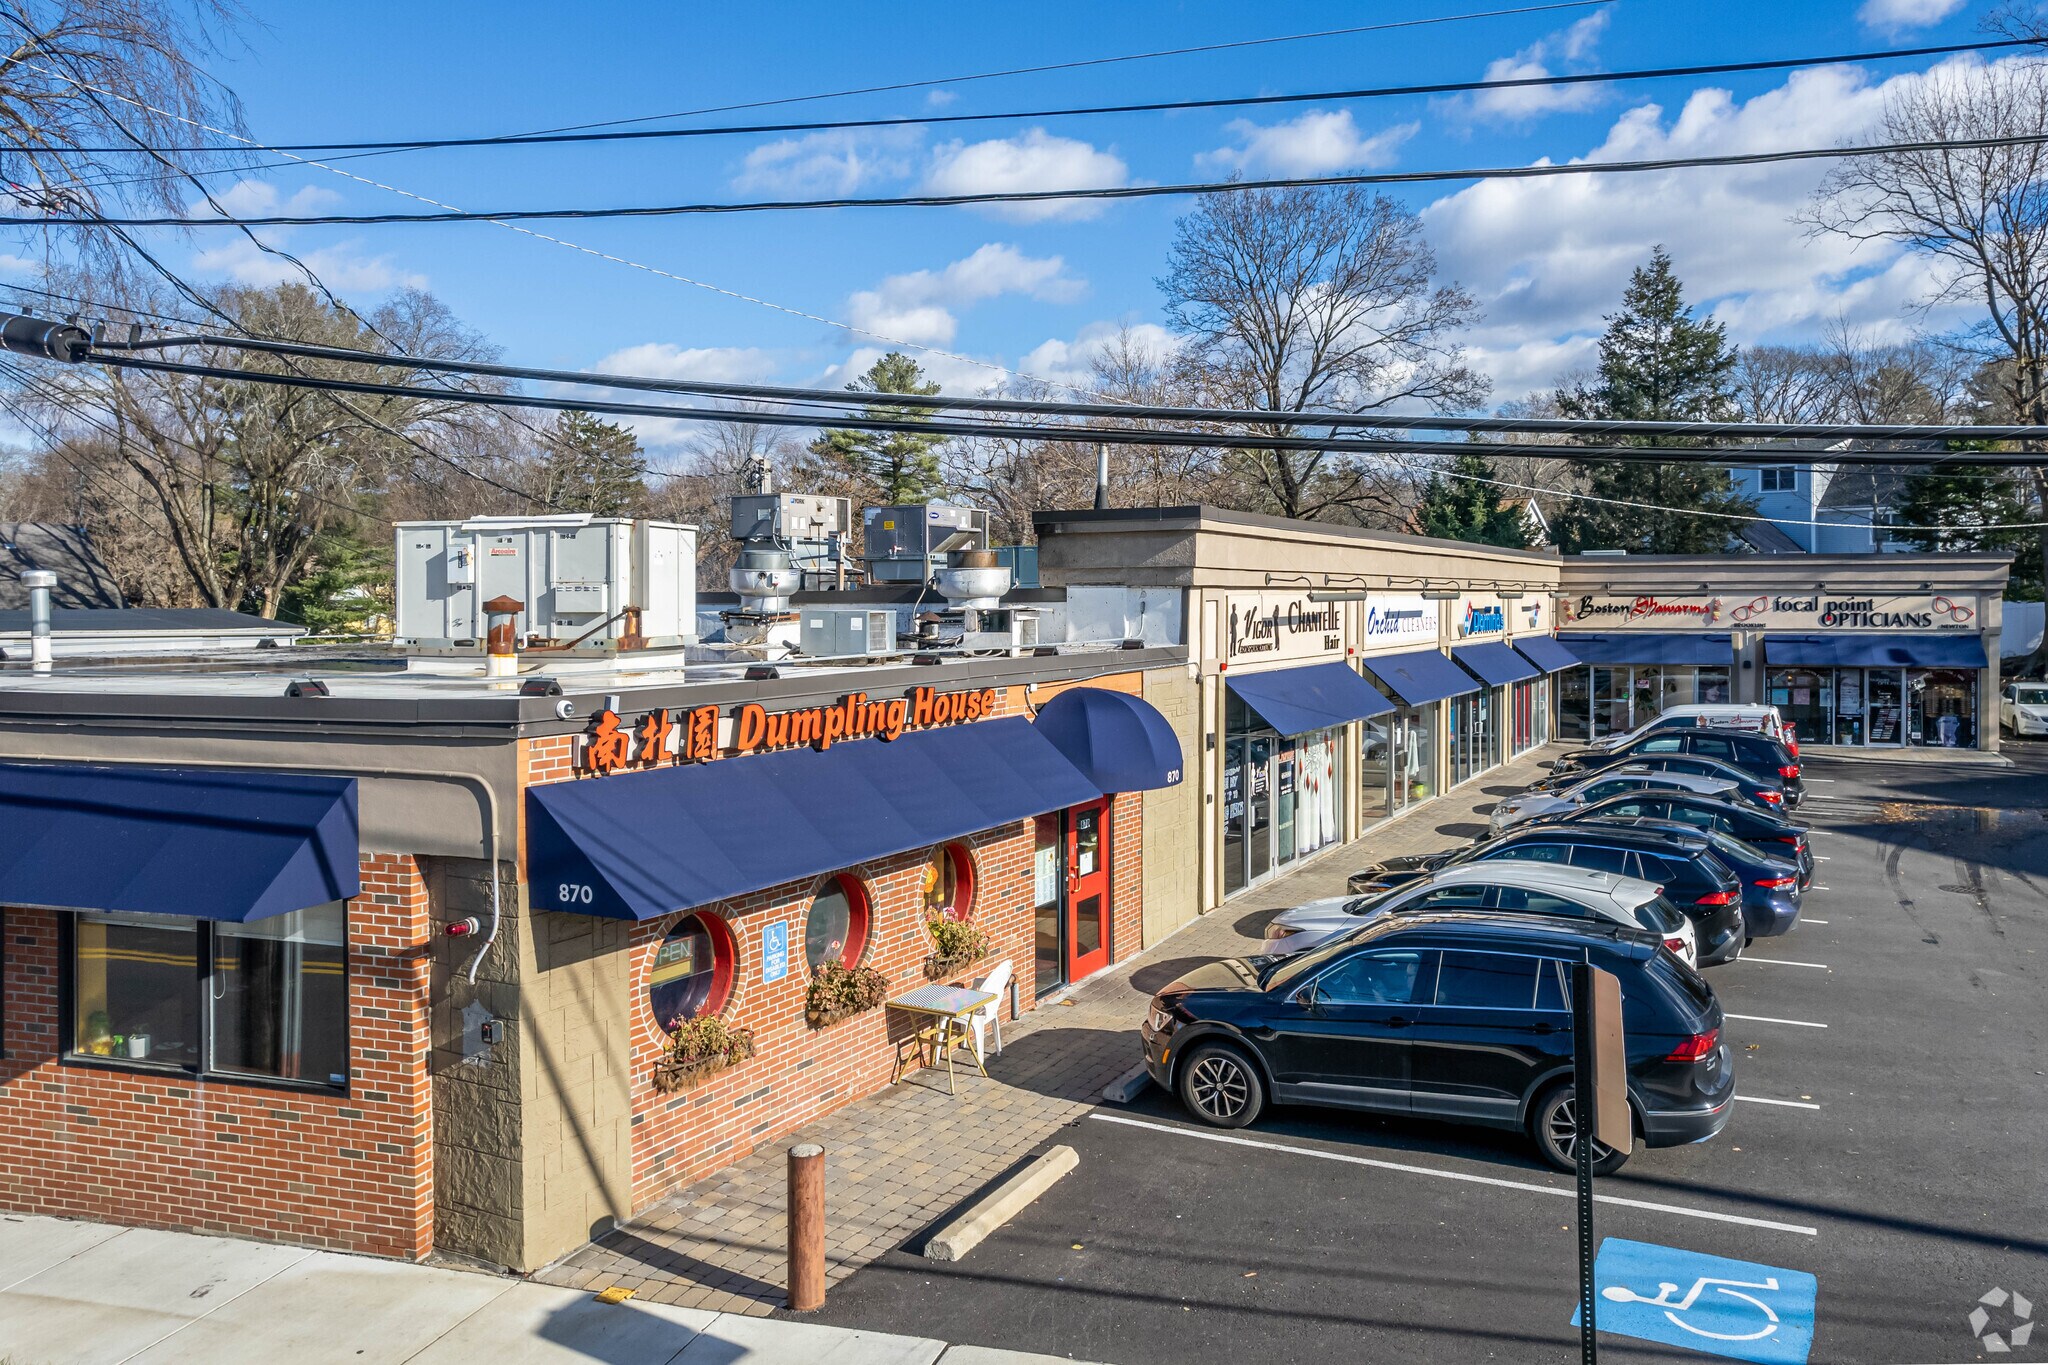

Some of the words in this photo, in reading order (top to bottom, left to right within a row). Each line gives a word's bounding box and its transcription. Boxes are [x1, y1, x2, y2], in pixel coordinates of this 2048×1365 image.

[1577, 595, 1630, 620] Boston
[1630, 595, 1710, 620] Shawarma
[1774, 596, 1818, 611] focal
[1827, 596, 1874, 618] point
[1244, 605, 1273, 639] VIGOR
[1367, 606, 1401, 635] Orchid
[1402, 615, 1437, 633] CLEANERS
[1821, 612, 1932, 628] OPTICIANS
[1324, 635, 1340, 650] Hair
[738, 692, 907, 750] Dumpling
[913, 686, 995, 725] House
[1167, 769, 1180, 784] 870
[559, 883, 593, 904] 870
[655, 940, 691, 965] PEN
